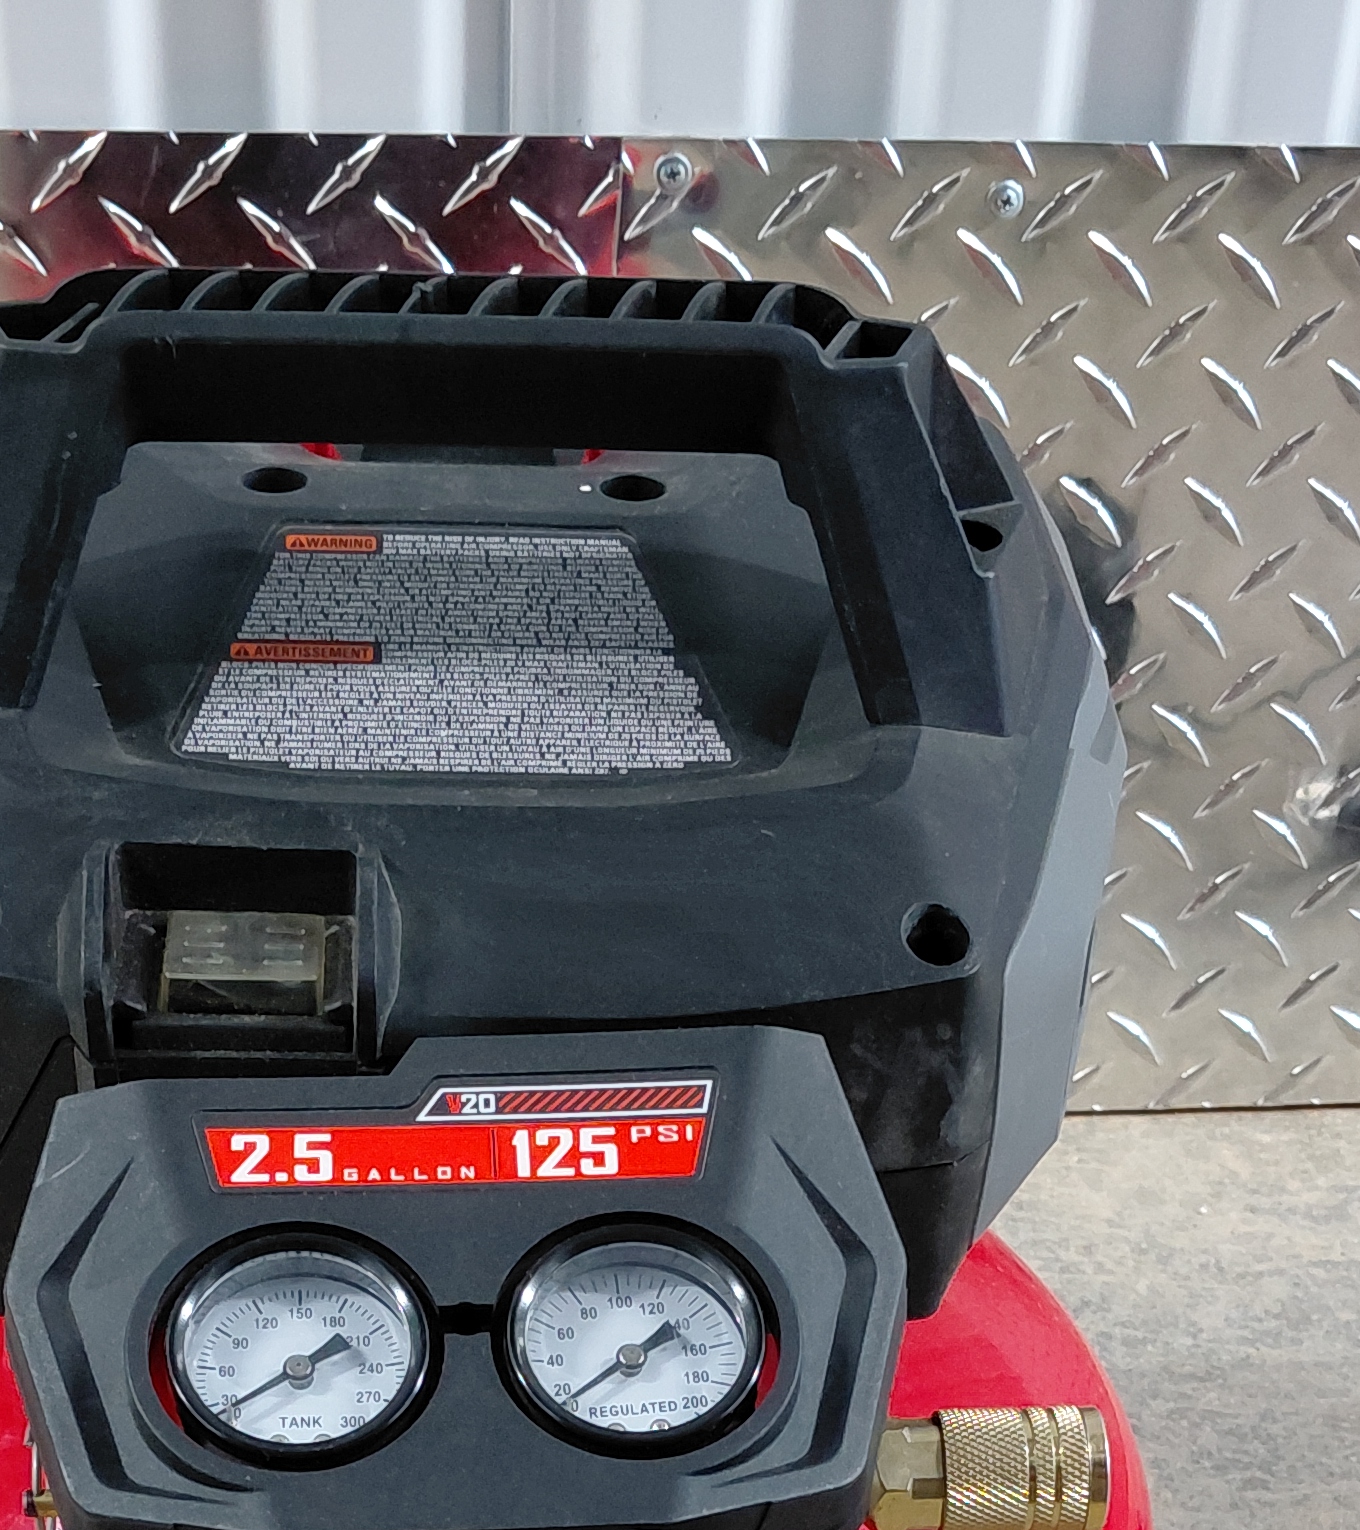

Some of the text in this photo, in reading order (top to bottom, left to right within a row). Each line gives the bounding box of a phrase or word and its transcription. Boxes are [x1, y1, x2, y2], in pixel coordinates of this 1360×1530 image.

[305, 536, 373, 549] WARNING
[253, 644, 370, 659] AVERTISSEMENT
[229, 1124, 694, 1184] 2.5 GALLON 125 PSI
[607, 1296, 633, 1309] 100
[639, 1302, 665, 1316] 120
[288, 1307, 313, 1320] 150
[580, 1307, 598, 1320] 80
[254, 1317, 279, 1330] 120
[321, 1316, 346, 1328] 180
[673, 1317, 691, 1331] 40
[557, 1326, 575, 1340] 60
[231, 1337, 249, 1350] 90
[346, 1335, 371, 1348] 210
[681, 1344, 707, 1357] 160
[546, 1354, 564, 1368] 40
[218, 1365, 236, 1378] 60
[358, 1363, 383, 1375] 240
[684, 1370, 710, 1384] 180
[355, 1390, 381, 1403] 270
[553, 1383, 572, 1397] 20
[220, 1393, 238, 1407] 30
[570, 1400, 579, 1413] 0
[681, 1395, 709, 1409] 200
[233, 1406, 242, 1419] 0
[588, 1400, 678, 1420] REGULATED
[279, 1416, 323, 1429] TANK
[340, 1415, 366, 1429] 300
